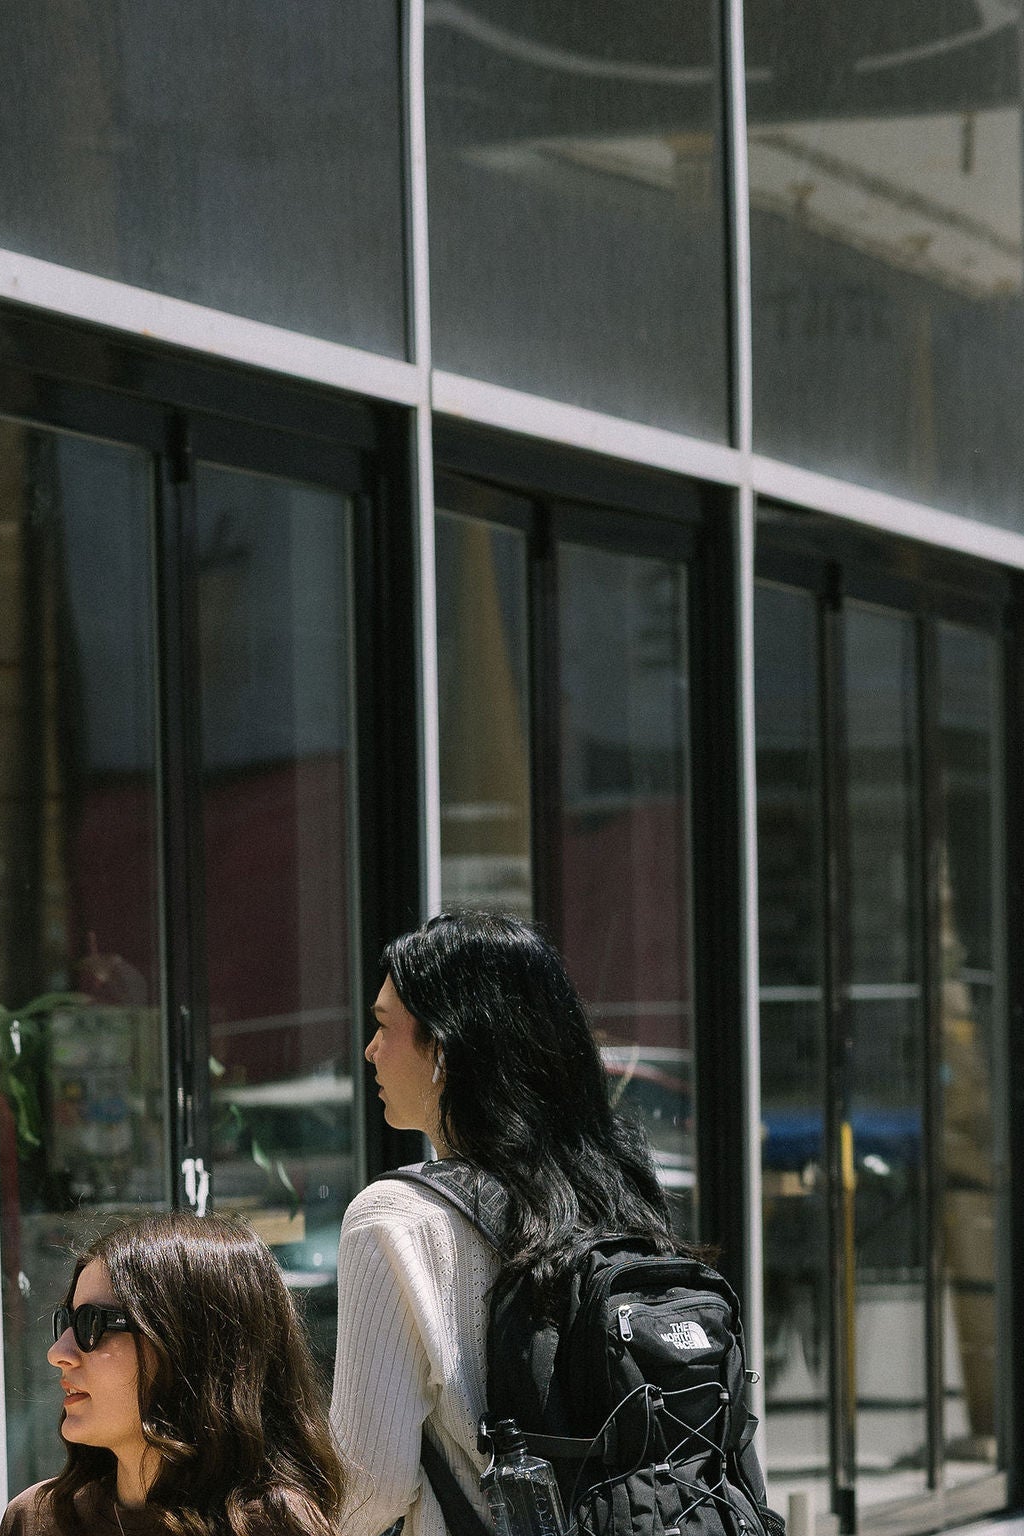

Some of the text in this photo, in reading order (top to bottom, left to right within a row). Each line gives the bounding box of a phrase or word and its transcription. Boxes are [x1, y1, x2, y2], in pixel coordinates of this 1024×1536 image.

[669, 1321, 690, 1333] THE
[660, 1331, 692, 1342] NORTH
[673, 1340, 696, 1350] FACE
